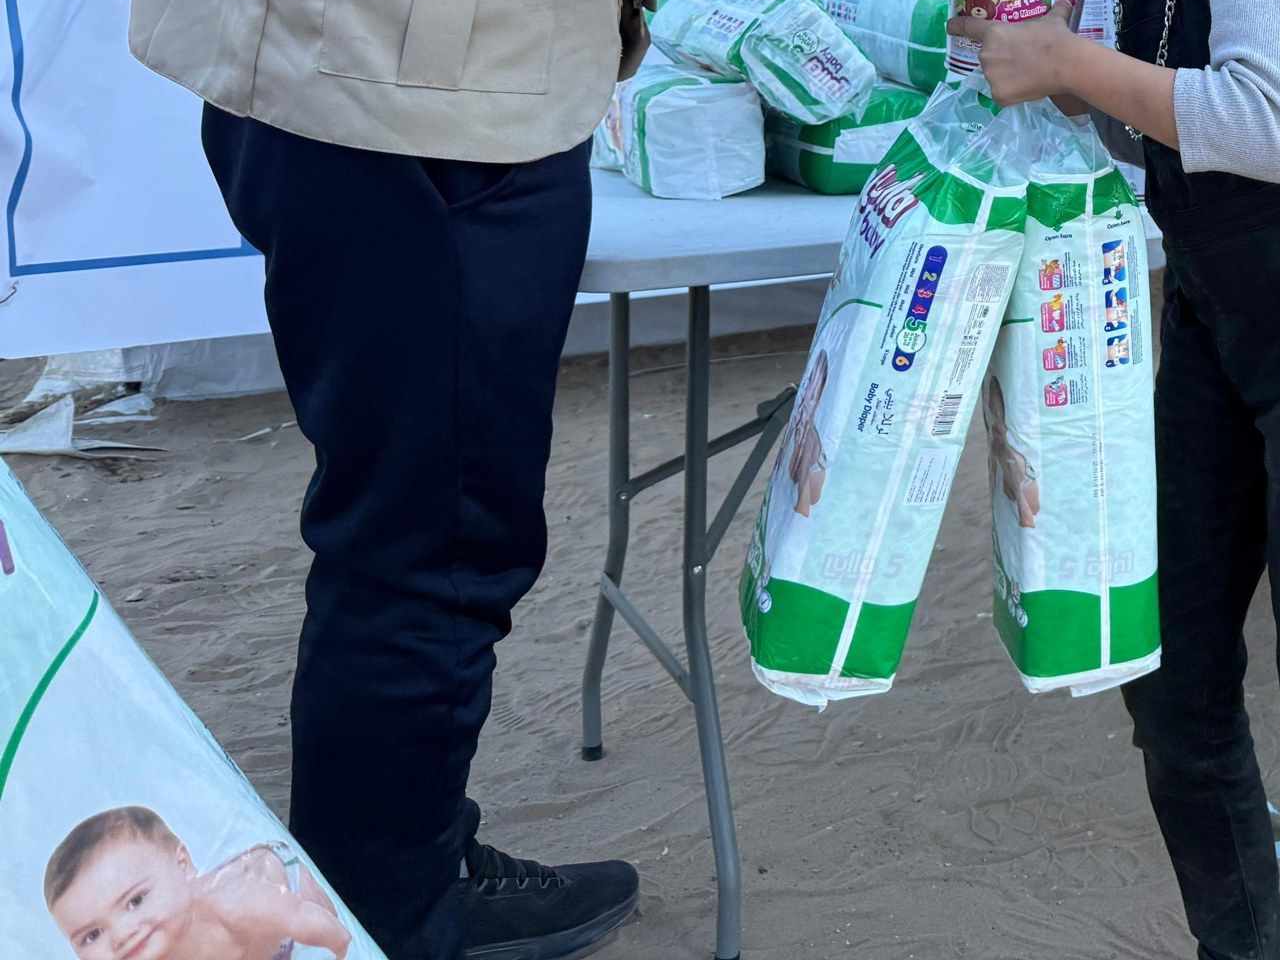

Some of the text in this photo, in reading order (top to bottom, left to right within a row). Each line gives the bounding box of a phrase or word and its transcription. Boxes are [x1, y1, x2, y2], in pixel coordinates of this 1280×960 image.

[820, 47, 843, 74] baby
[923, 271, 938, 282] 2
[917, 288, 933, 298] 3
[912, 304, 926, 314] 4
[905, 316, 928, 334] 5
[895, 356, 910, 366] 6
[857, 382, 879, 432] Baby Diaper
